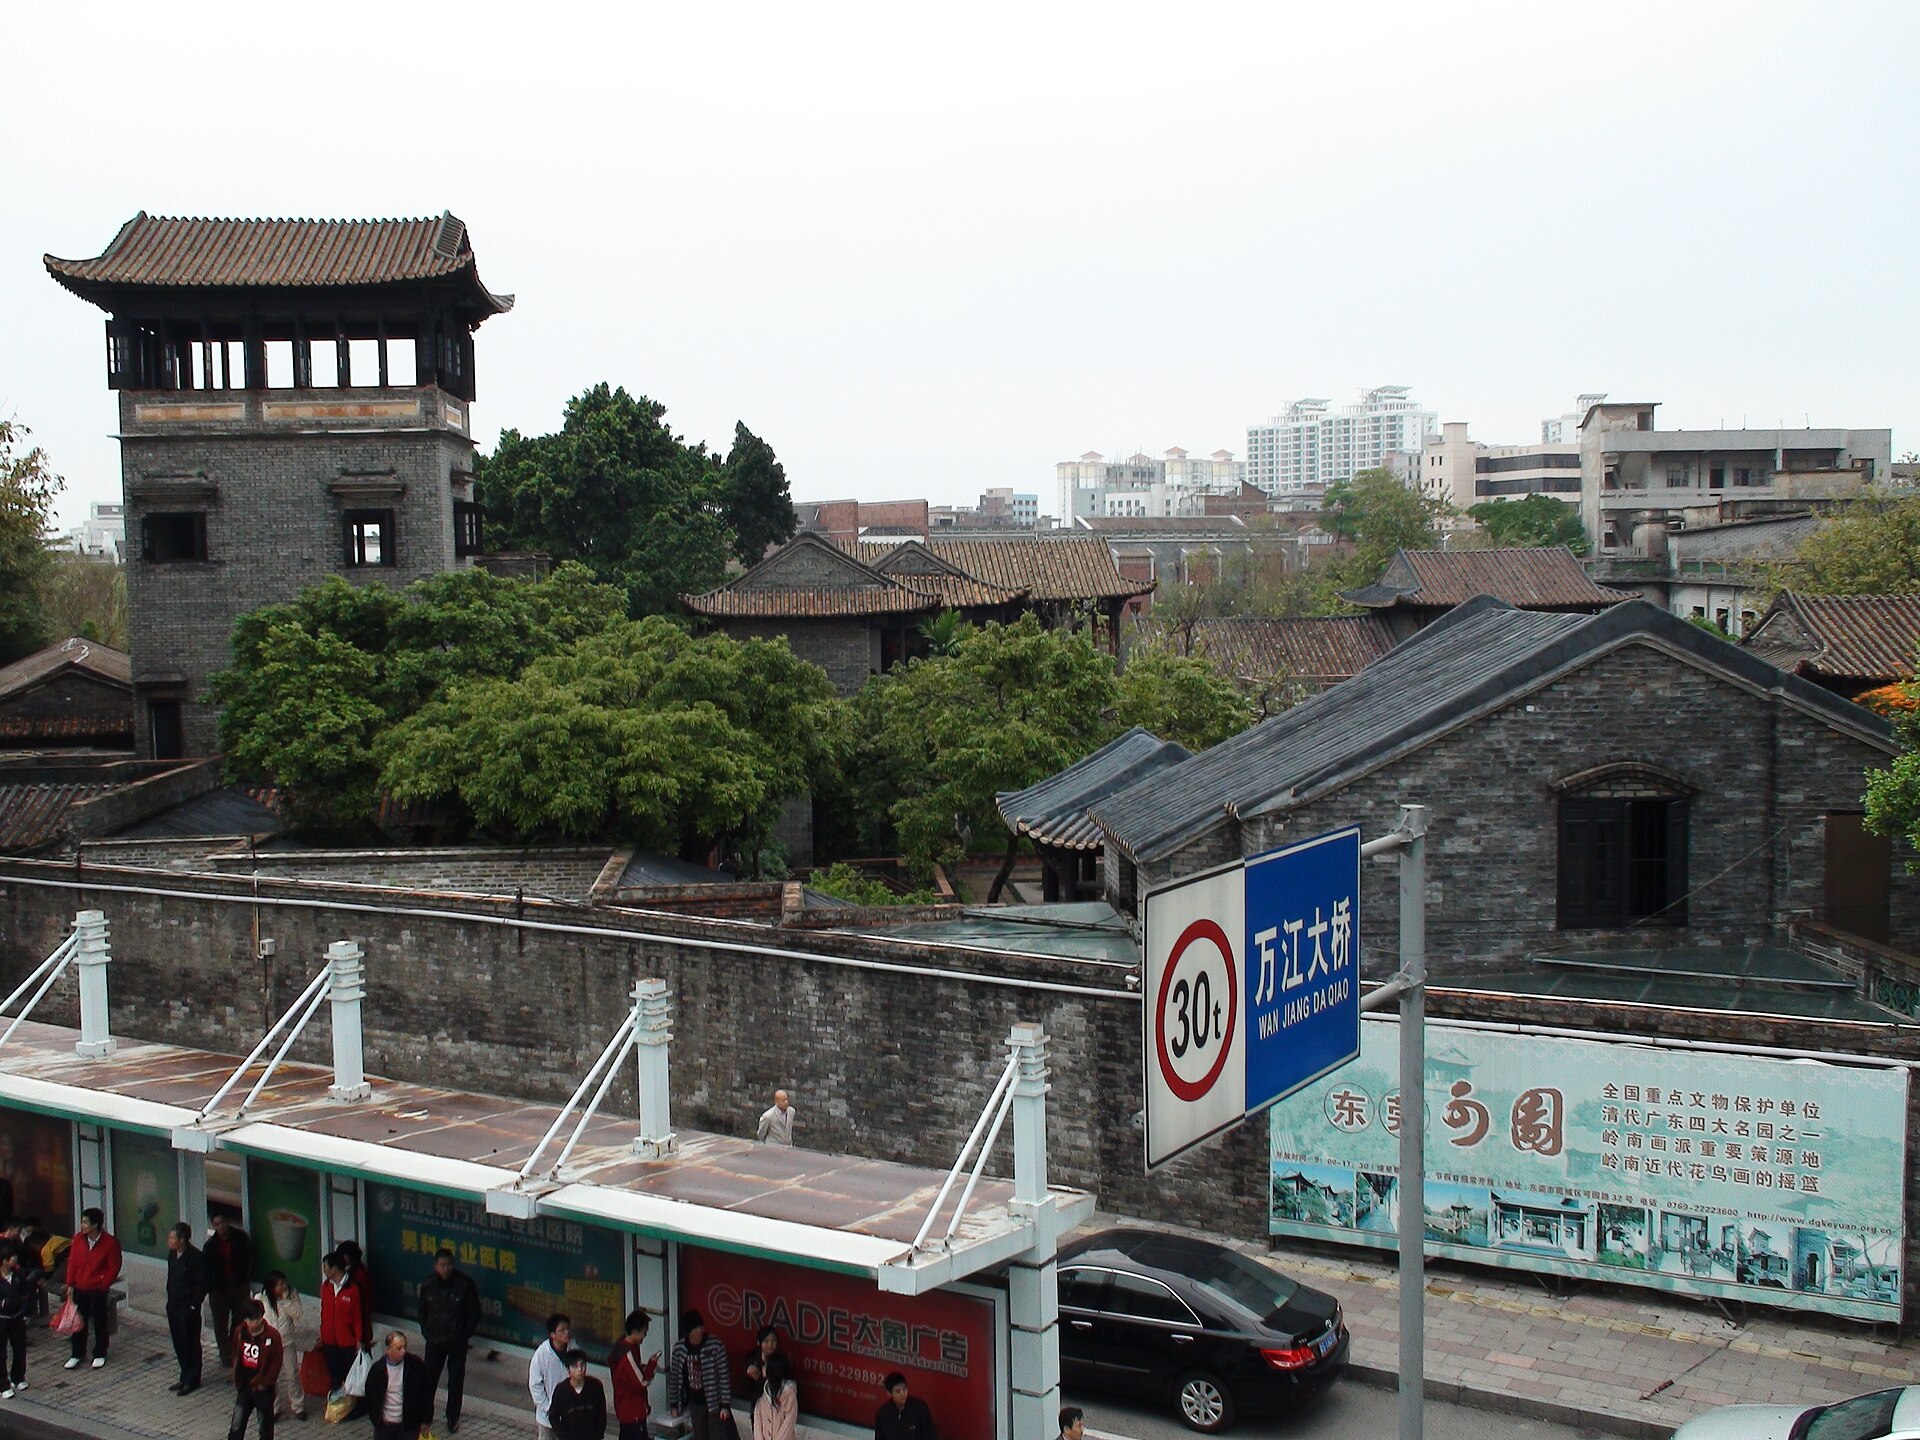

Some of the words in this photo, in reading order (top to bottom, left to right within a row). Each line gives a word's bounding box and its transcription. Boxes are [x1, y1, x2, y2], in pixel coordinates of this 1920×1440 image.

[1254, 895, 1352, 1007] 万江大桥
[1258, 1014, 1279, 1040] WAN
[1282, 997, 1310, 1030] JIANG
[1313, 990, 1327, 1015] DA
[1327, 980, 1350, 1007] QIAO
[1602, 1083, 1821, 1120] 全国重点文物保护单位
[1602, 1106, 1820, 1142] 清代广东四大名园之一
[1602, 1129, 1821, 1169] 岭南画派重要策源地
[1601, 1153, 1820, 1193] 岭南近代花鸟画的摇篮
[1666, 1201, 1739, 1217] 0769-22223600
[707, 1283, 850, 1351] GRADE
[850, 1312, 969, 1367] 大象广告
